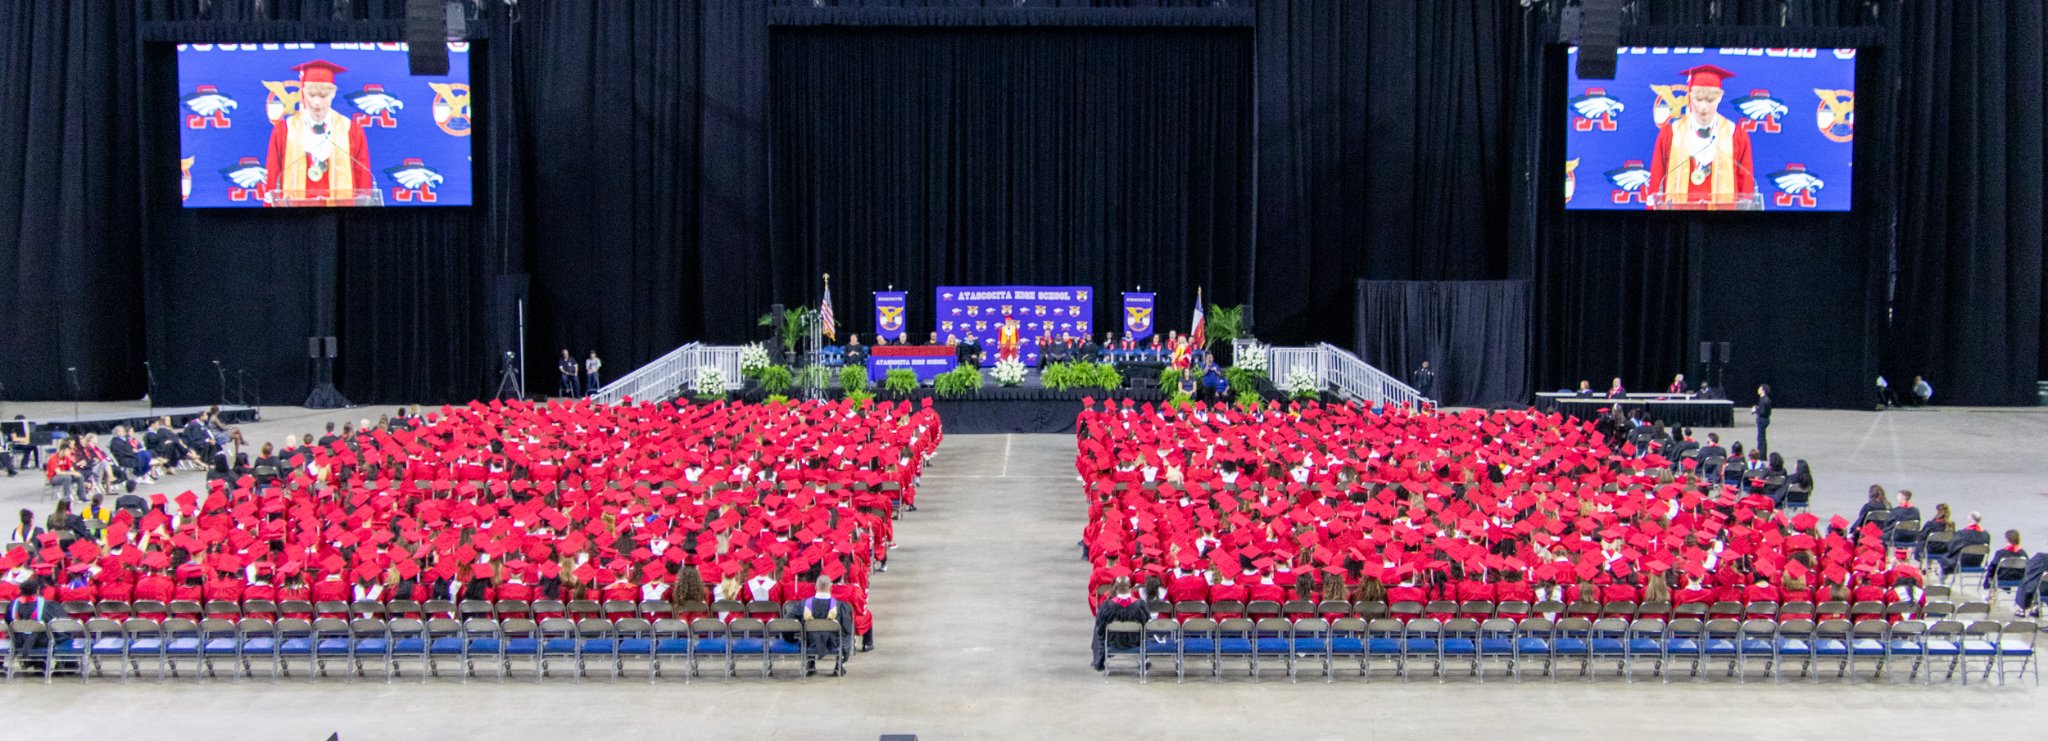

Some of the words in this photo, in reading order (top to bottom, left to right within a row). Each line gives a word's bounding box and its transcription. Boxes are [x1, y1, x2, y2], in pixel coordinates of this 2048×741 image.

[958, 291, 1012, 300] ATASCOCITA
[1014, 291, 1035, 300] HIGH
[1038, 291, 1070, 300] SCHOOL
